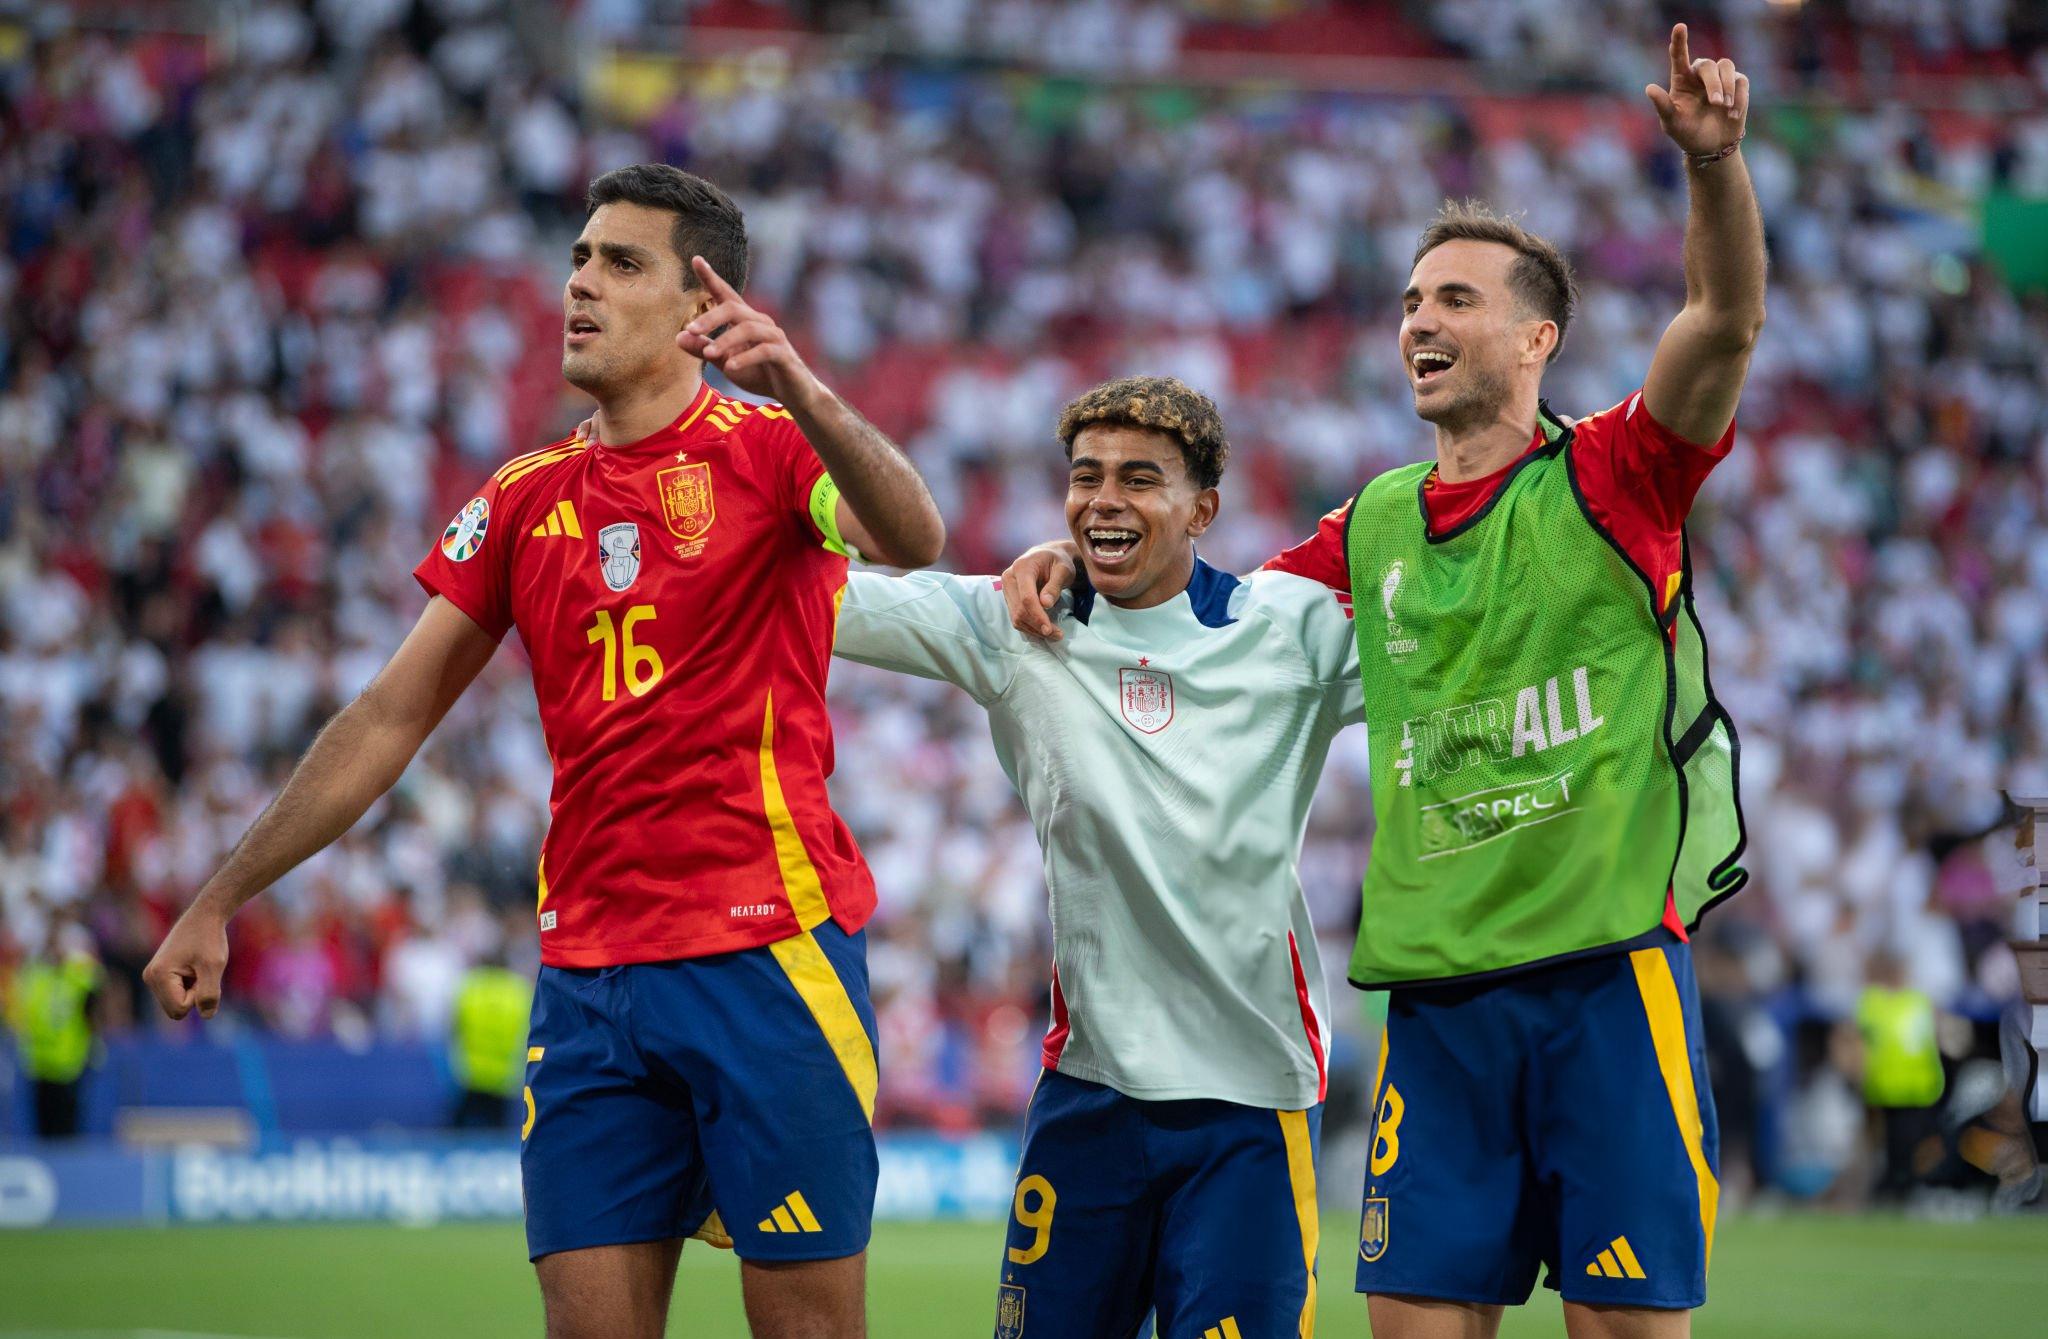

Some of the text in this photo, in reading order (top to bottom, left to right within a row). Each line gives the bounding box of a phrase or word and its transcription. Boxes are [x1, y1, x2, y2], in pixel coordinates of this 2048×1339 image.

[586, 604, 664, 701] 16
[730, 904, 776, 917] HEAT.RDY
[1370, 1083, 1405, 1176] 8
[1008, 1174, 1057, 1265] 9
